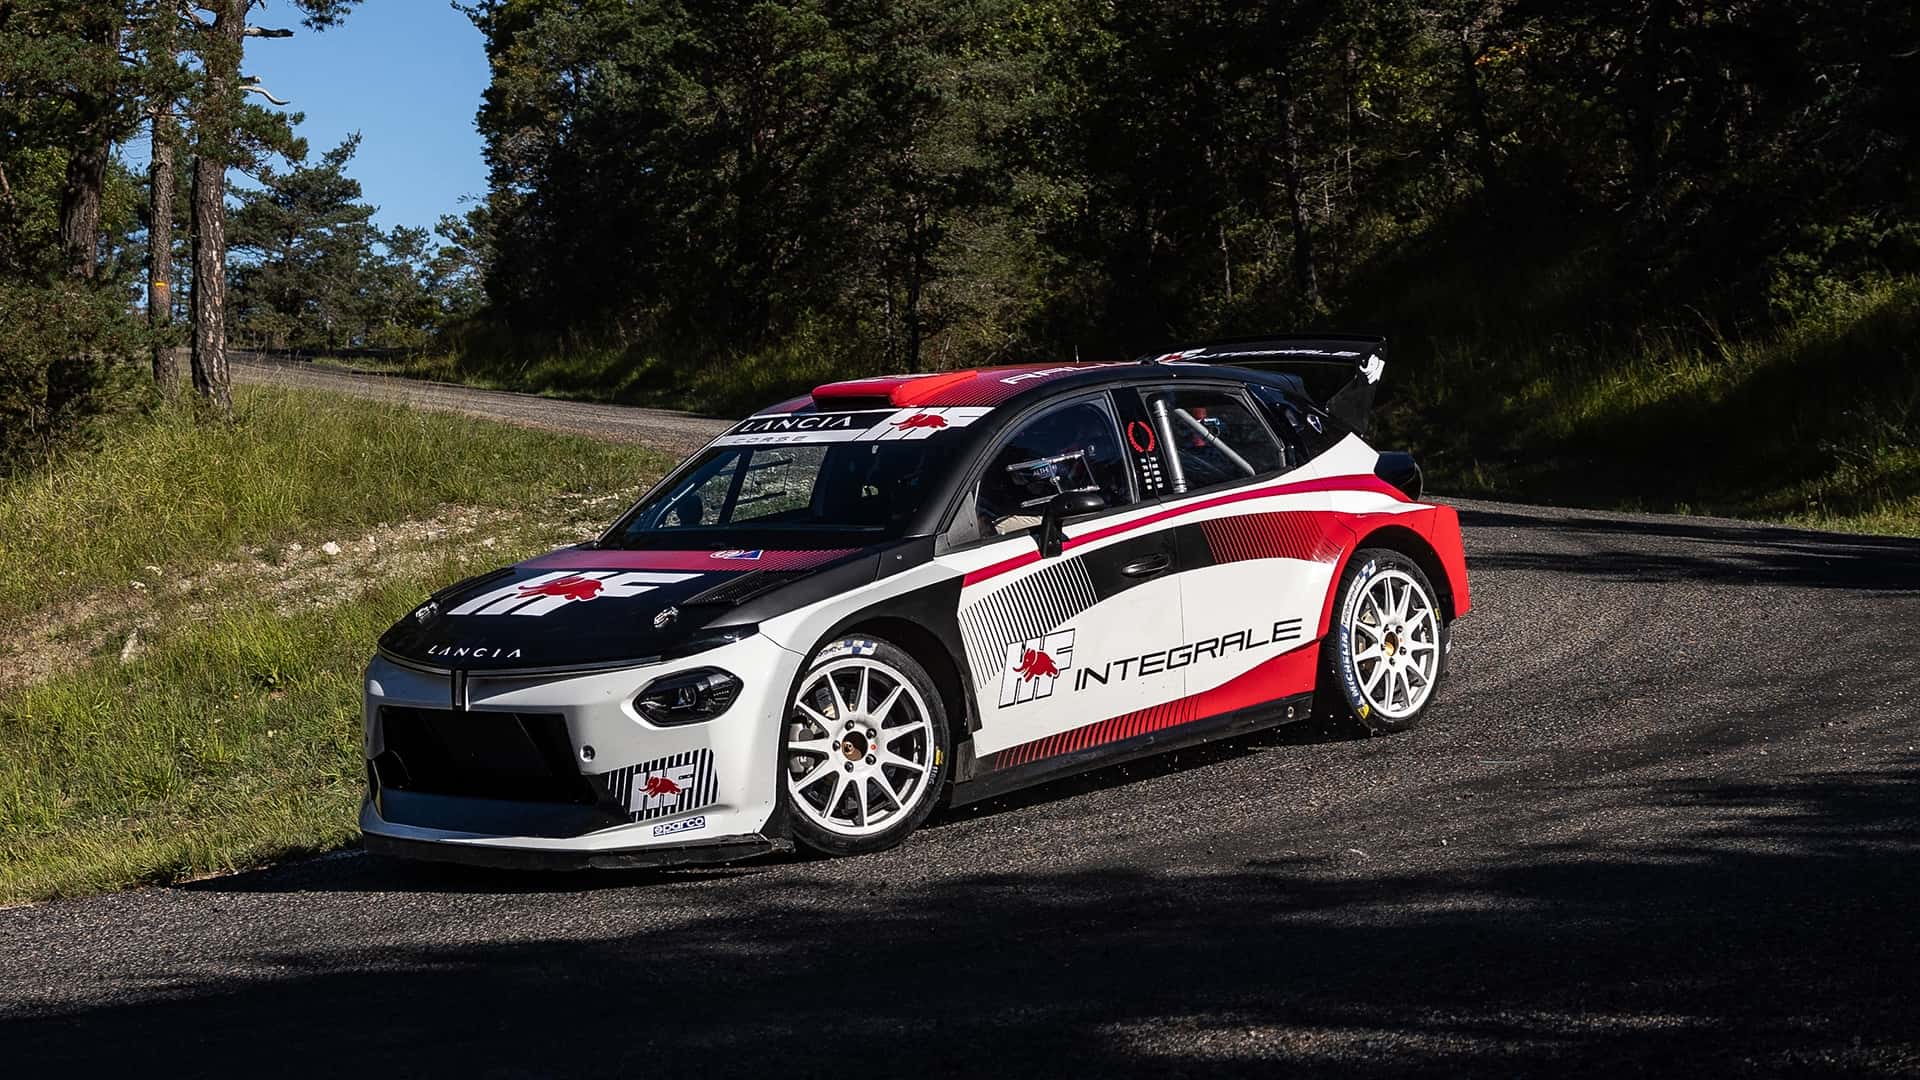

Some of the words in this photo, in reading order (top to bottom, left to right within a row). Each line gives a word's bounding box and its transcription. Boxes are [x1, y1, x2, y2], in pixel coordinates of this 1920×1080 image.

[739, 416, 852, 434] LANCIA
[428, 644, 522, 659] LANCIA
[999, 627, 1076, 709] HF
[1075, 618, 1303, 692] INTEGRALE
[1341, 632, 1359, 698] MICHELIN
[630, 763, 695, 812] HF
[654, 816, 705, 836] sparco
